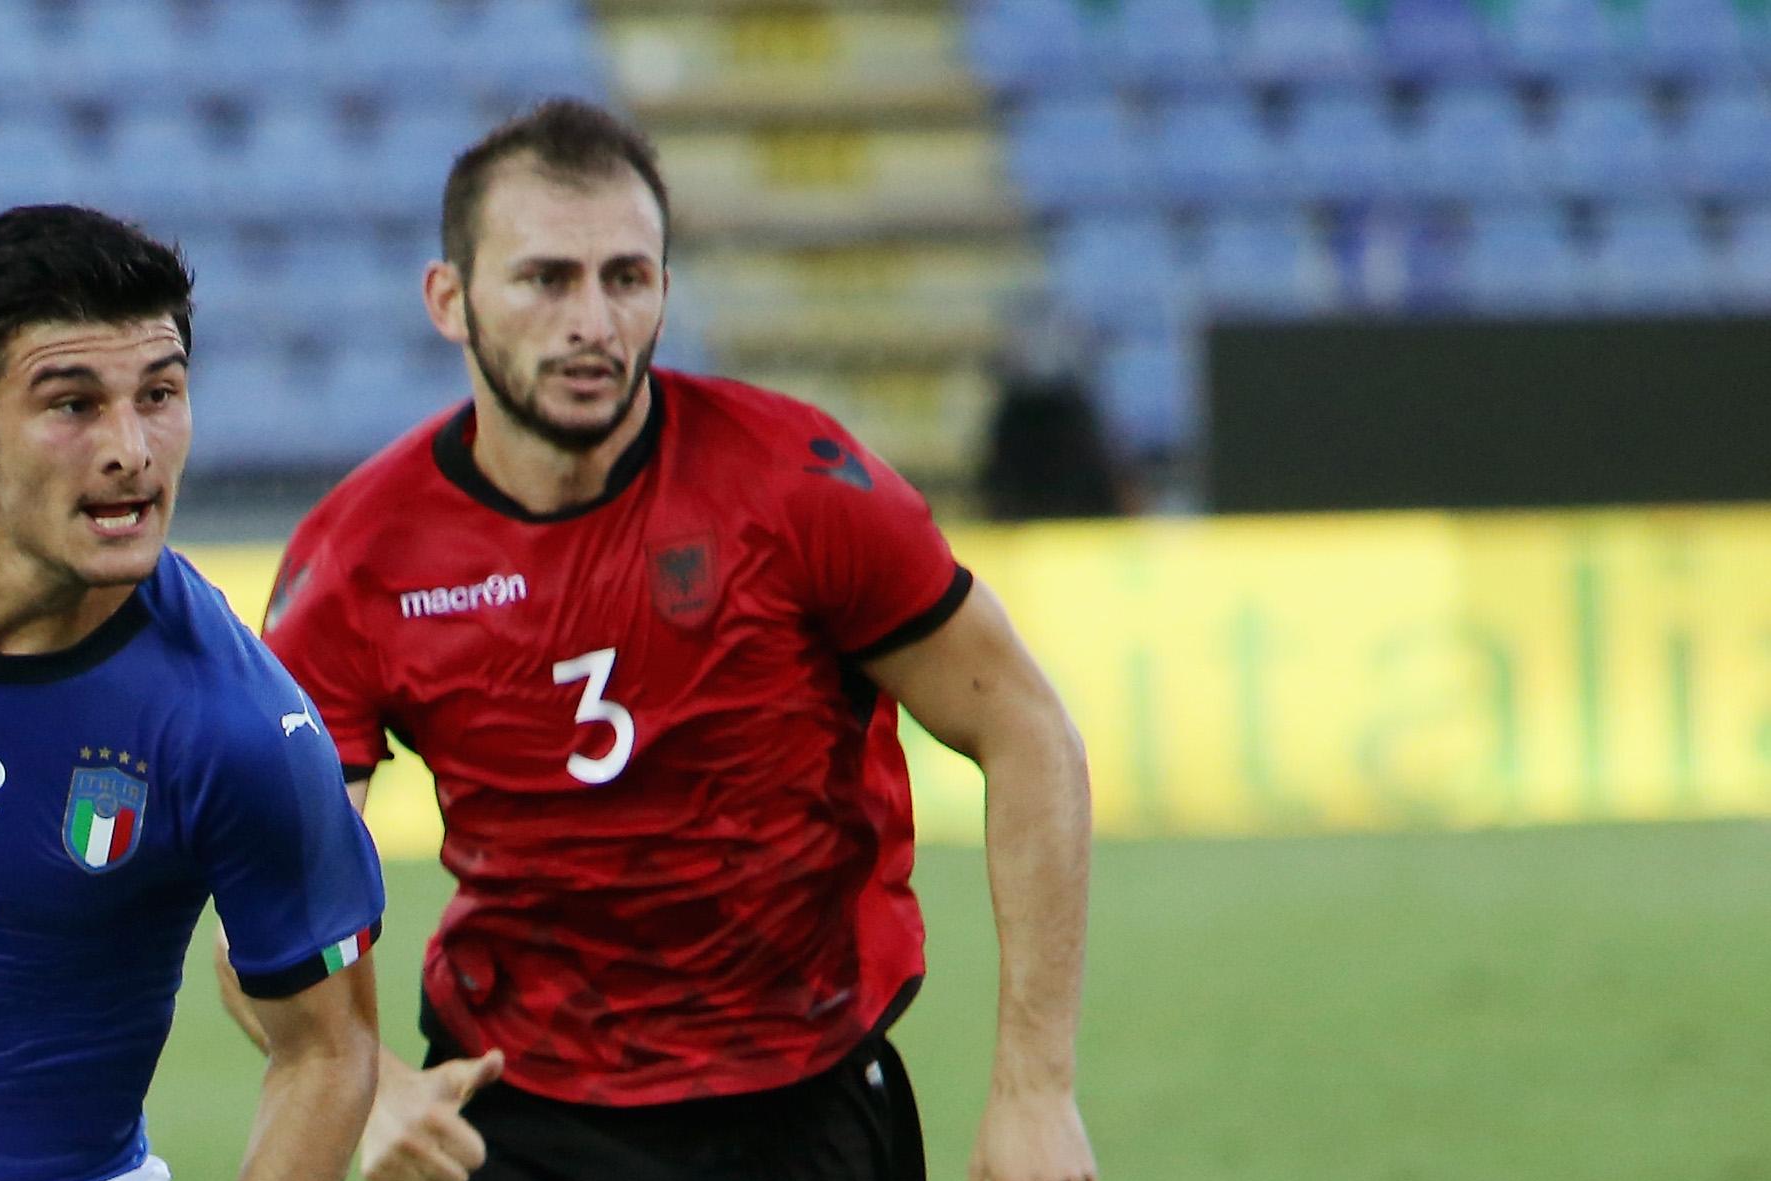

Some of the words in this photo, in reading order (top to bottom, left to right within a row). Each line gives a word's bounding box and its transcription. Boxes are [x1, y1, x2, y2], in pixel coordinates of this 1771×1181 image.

[400, 573, 527, 619] macron
[552, 647, 635, 784] 3
[1114, 538, 1771, 812] itali
